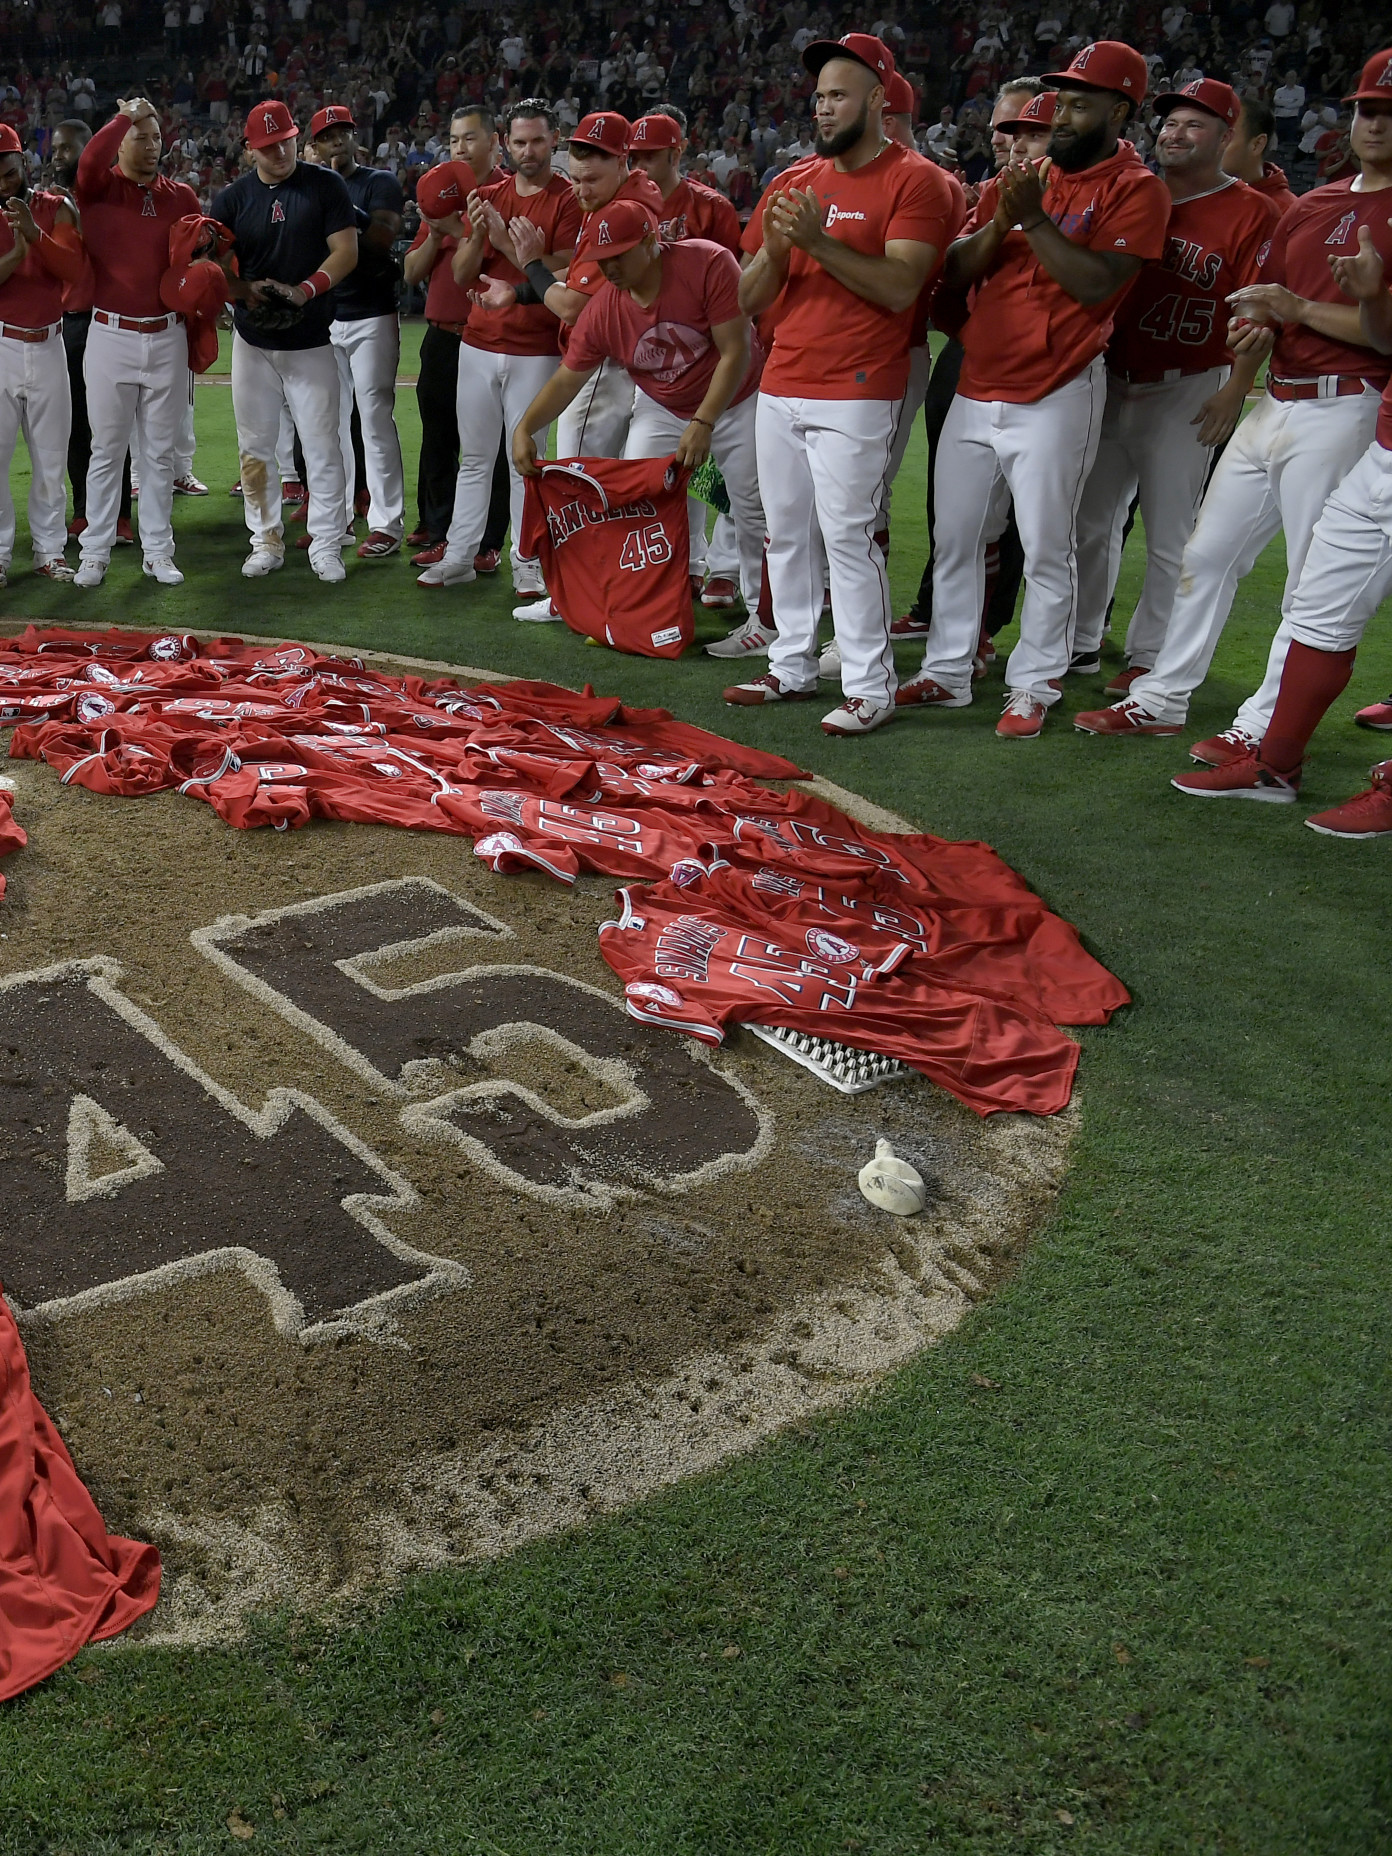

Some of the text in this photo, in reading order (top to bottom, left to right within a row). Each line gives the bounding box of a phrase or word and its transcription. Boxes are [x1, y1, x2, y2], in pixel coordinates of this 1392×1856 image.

[1138, 293, 1217, 346] 45
[620, 522, 673, 571] 45
[728, 934, 858, 1011] 45
